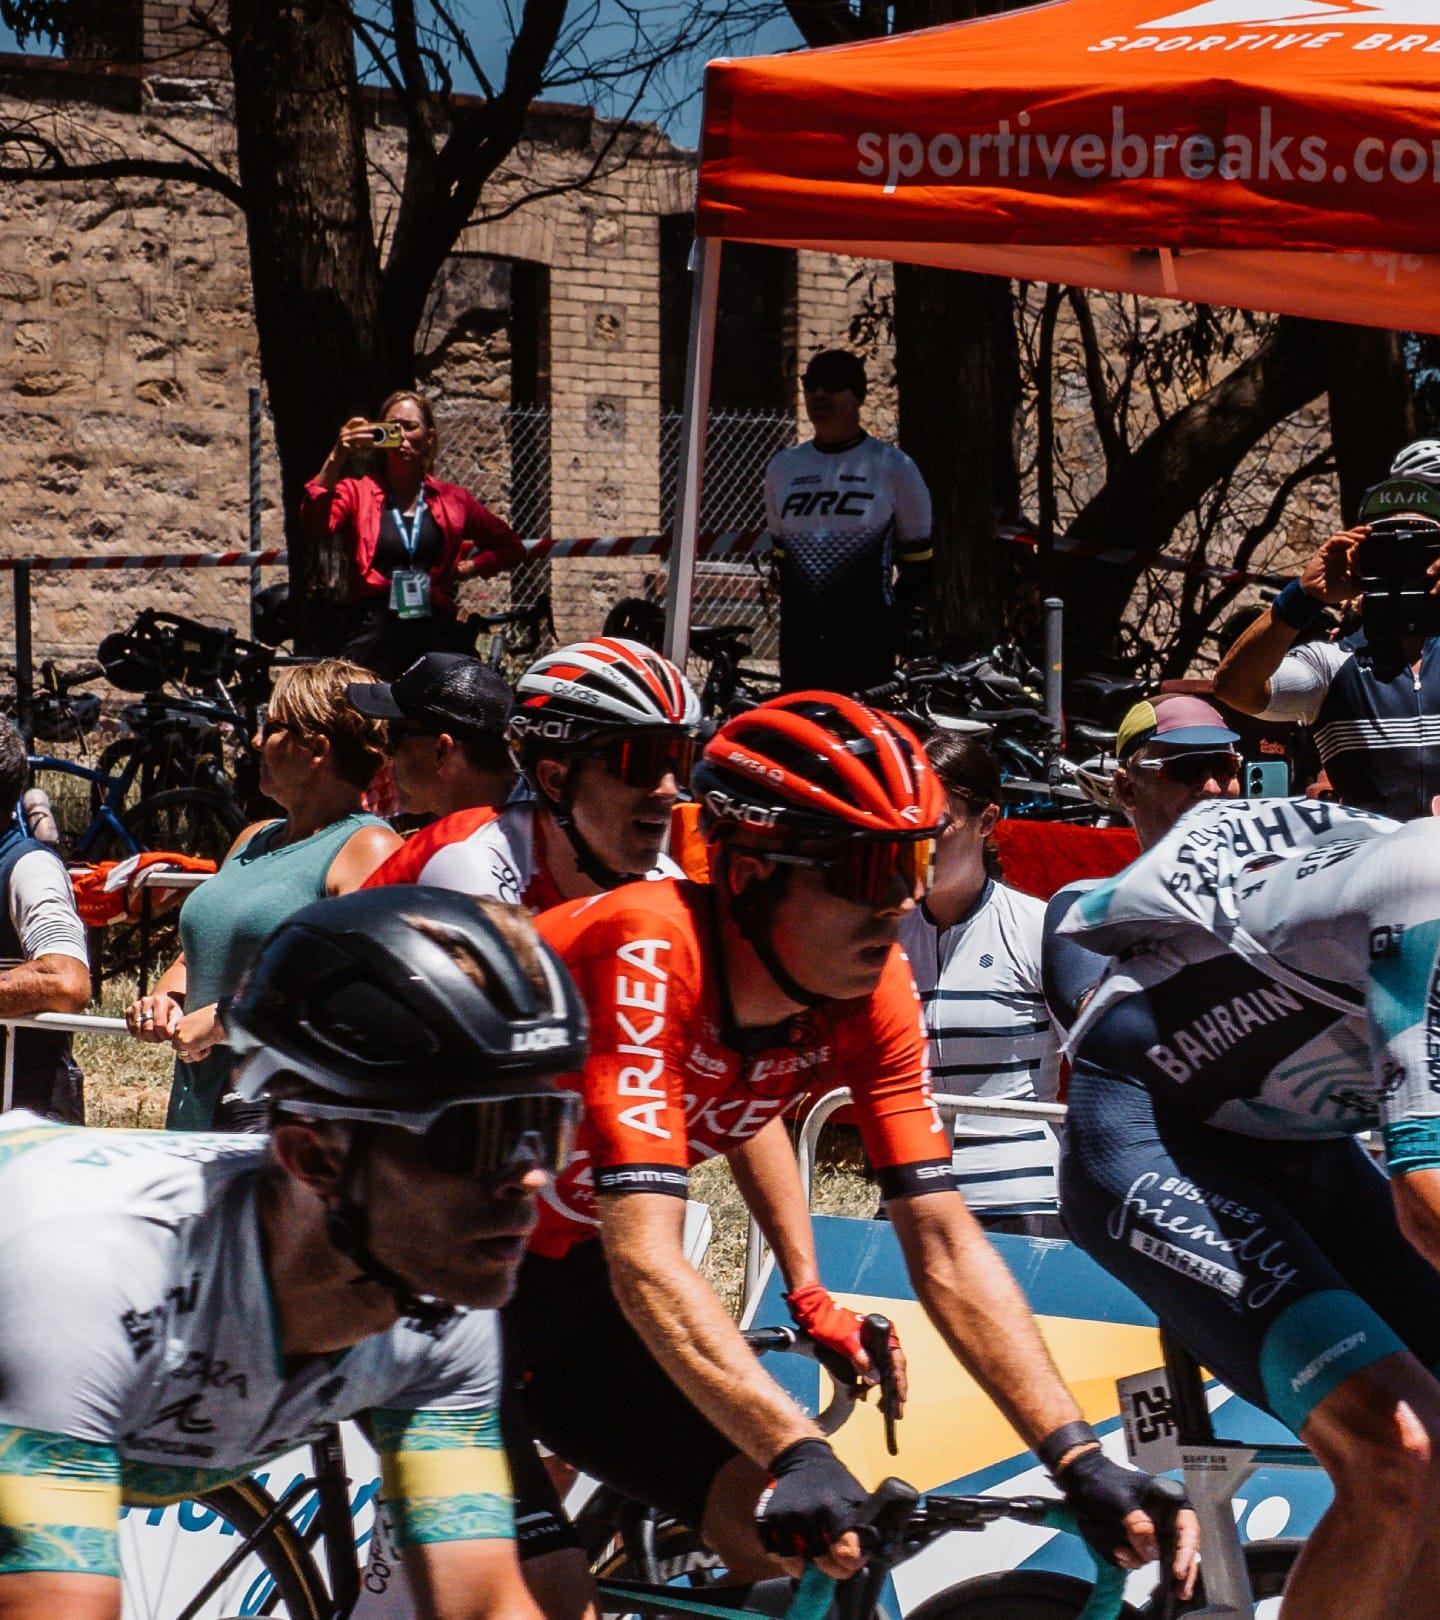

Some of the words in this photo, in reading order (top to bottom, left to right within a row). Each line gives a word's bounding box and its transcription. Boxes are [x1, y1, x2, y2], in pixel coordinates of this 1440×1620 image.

[1087, 31, 1345, 53] SPORTIVE
[780, 490, 876, 520] ARC
[616, 938, 672, 1140] ARKEA
[1146, 983, 1304, 1084] BAHRAIN
[1107, 1171, 1299, 1309] friendly
[1131, 1385, 1178, 1444] 25
